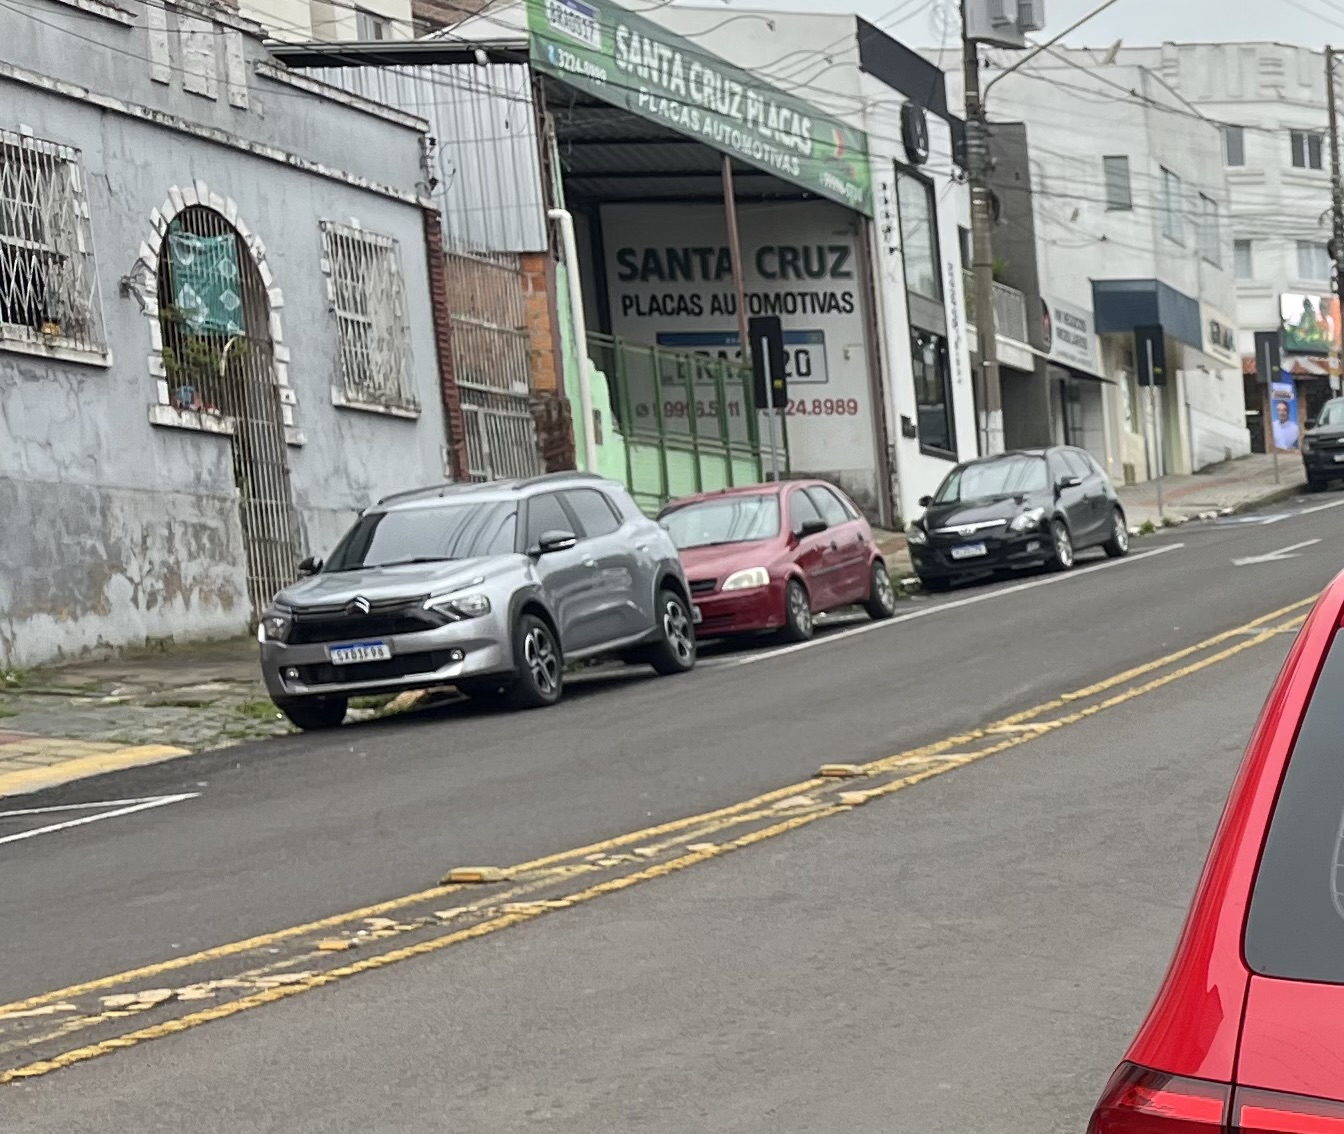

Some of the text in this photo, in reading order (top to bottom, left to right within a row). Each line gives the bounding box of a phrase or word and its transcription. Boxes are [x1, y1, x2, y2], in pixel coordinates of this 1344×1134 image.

[615, 25, 812, 156] SANTA CRUZ PLACAS
[638, 86, 801, 177] PLACAS AUTOMOTIVAS
[616, 245, 854, 283] SANTA CRUZ
[622, 292, 703, 317] PLACAS
